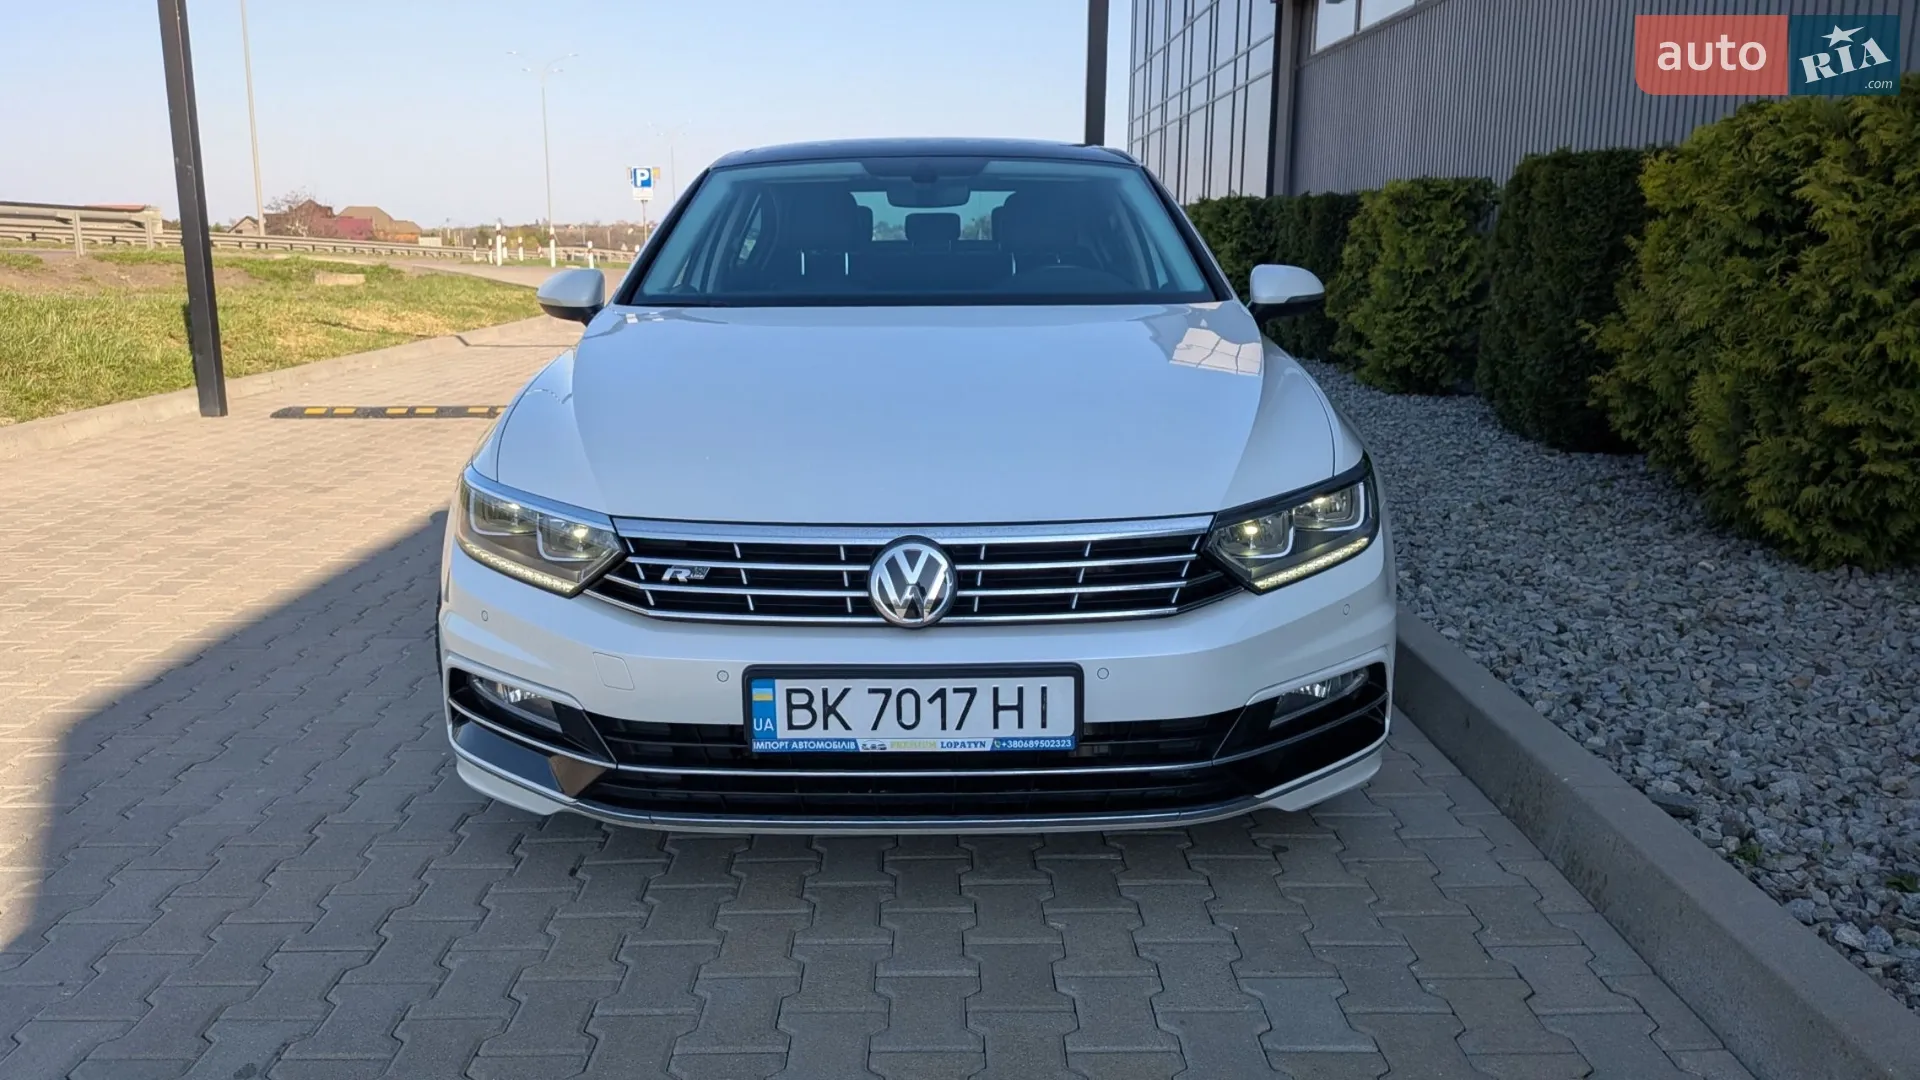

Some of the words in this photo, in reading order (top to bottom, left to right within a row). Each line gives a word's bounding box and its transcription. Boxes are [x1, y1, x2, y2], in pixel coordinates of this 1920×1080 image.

[636, 169, 650, 187] P
[785, 687, 853, 731] BK
[867, 687, 978, 731] 7017
[992, 686, 1048, 729] HI
[753, 719, 775, 731] UA
[753, 741, 789, 750] ІМПОРТ
[792, 741, 856, 750] АВТОМОБІЛІВ
[940, 740, 987, 749] LOPATYN
[1001, 739, 1072, 748] +380689502323
